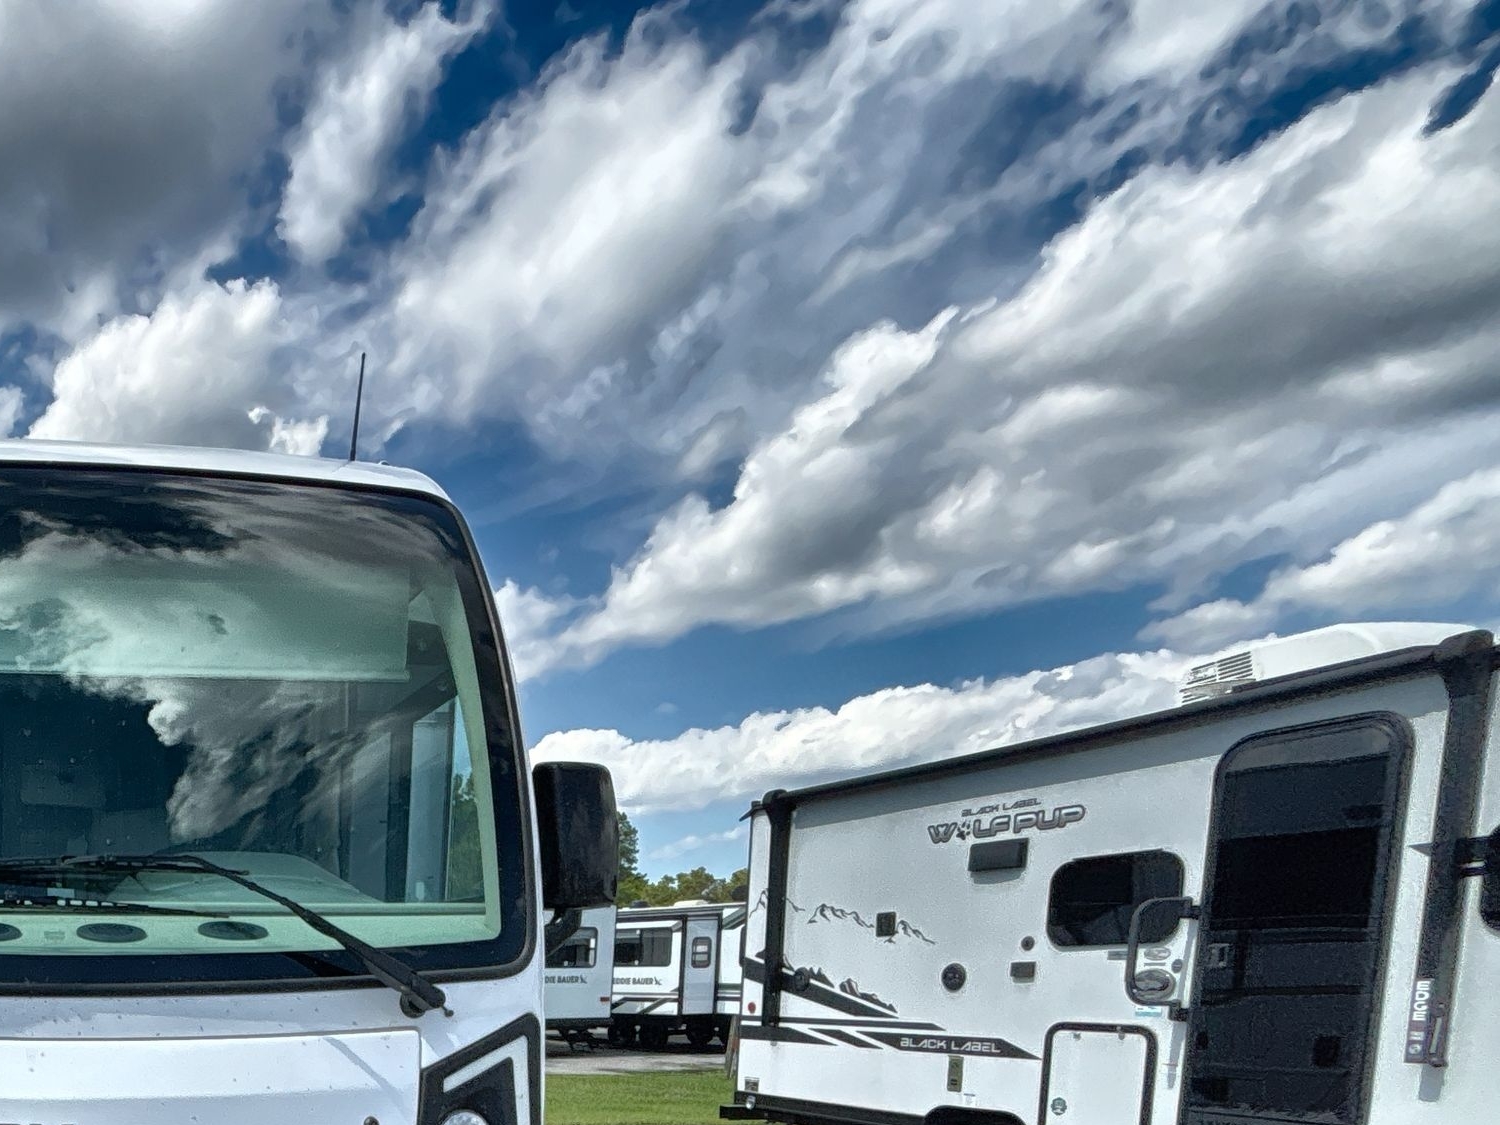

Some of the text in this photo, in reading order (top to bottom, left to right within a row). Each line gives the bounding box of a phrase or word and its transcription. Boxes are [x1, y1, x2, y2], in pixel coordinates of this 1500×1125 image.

[961, 798, 1041, 817] BLACK LABEL
[927, 804, 1085, 844] WLF PUP
[900, 1037, 1001, 1053] BLACK LABEL
